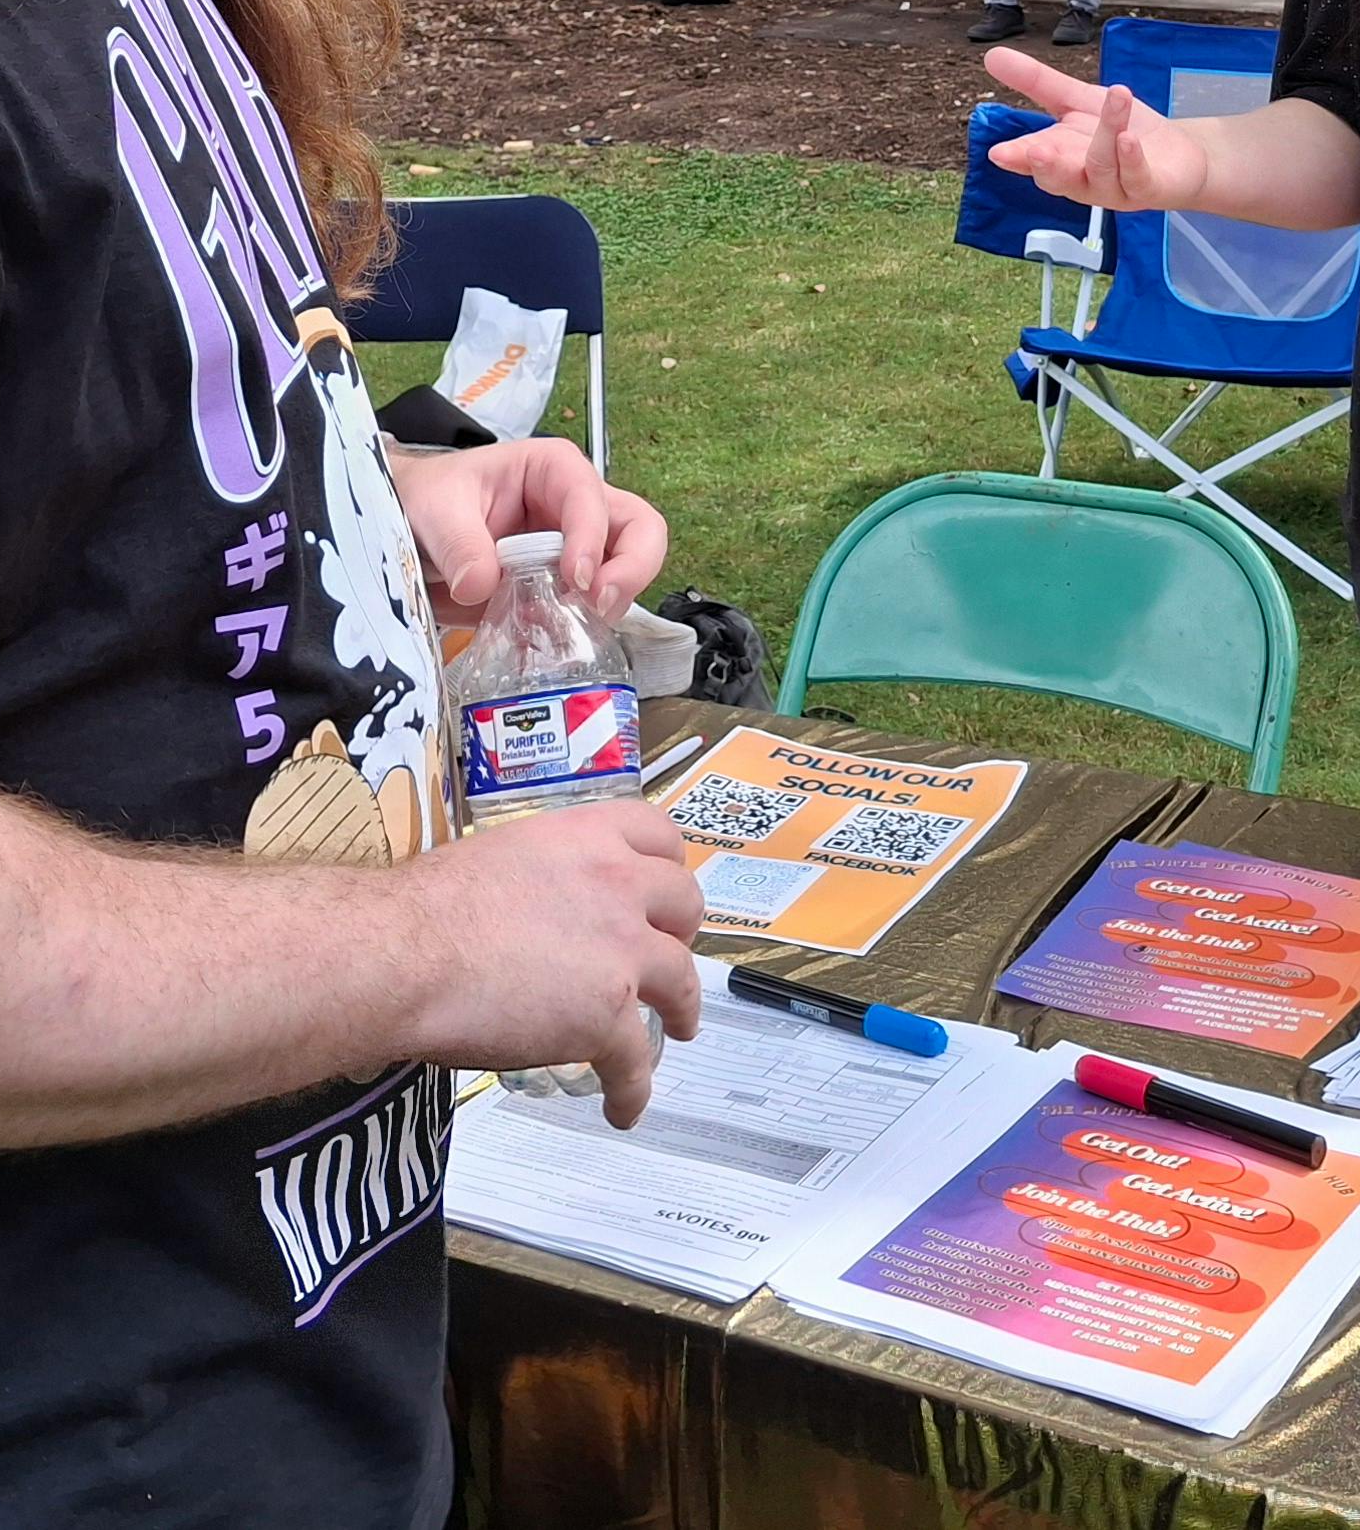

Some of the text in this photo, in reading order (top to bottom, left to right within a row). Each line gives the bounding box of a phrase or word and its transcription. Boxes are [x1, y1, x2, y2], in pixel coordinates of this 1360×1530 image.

[501, 745, 563, 761] Drinking Water
[505, 732, 555, 750] PURIFIED
[769, 746, 974, 792] FOLLOW OUR
[778, 775, 921, 806] SOCIALS!
[681, 831, 745, 850] SCORD
[804, 852, 921, 877] FACEBOOK
[1150, 879, 1245, 905] Get Out!
[1274, 871, 1354, 898] COMMUNITY
[1194, 907, 1320, 936] Get Active!
[1105, 919, 1255, 952] Join the Hub!
[1080, 1132, 1191, 1170] Get Out!
[1122, 1174, 1267, 1222] Get Active!
[1323, 1175, 1354, 1196] HUB
[1011, 1184, 1183, 1238] Join the Hub!
[654, 1208, 771, 1244] scVOTES.gov
[1096, 1281, 1121, 1293] GET
[1124, 1287, 1137, 1297] IN
[1072, 1329, 1140, 1353] FACEBOOK
[1168, 1342, 1196, 1355] AND
[1184, 1331, 1201, 1344] ON
